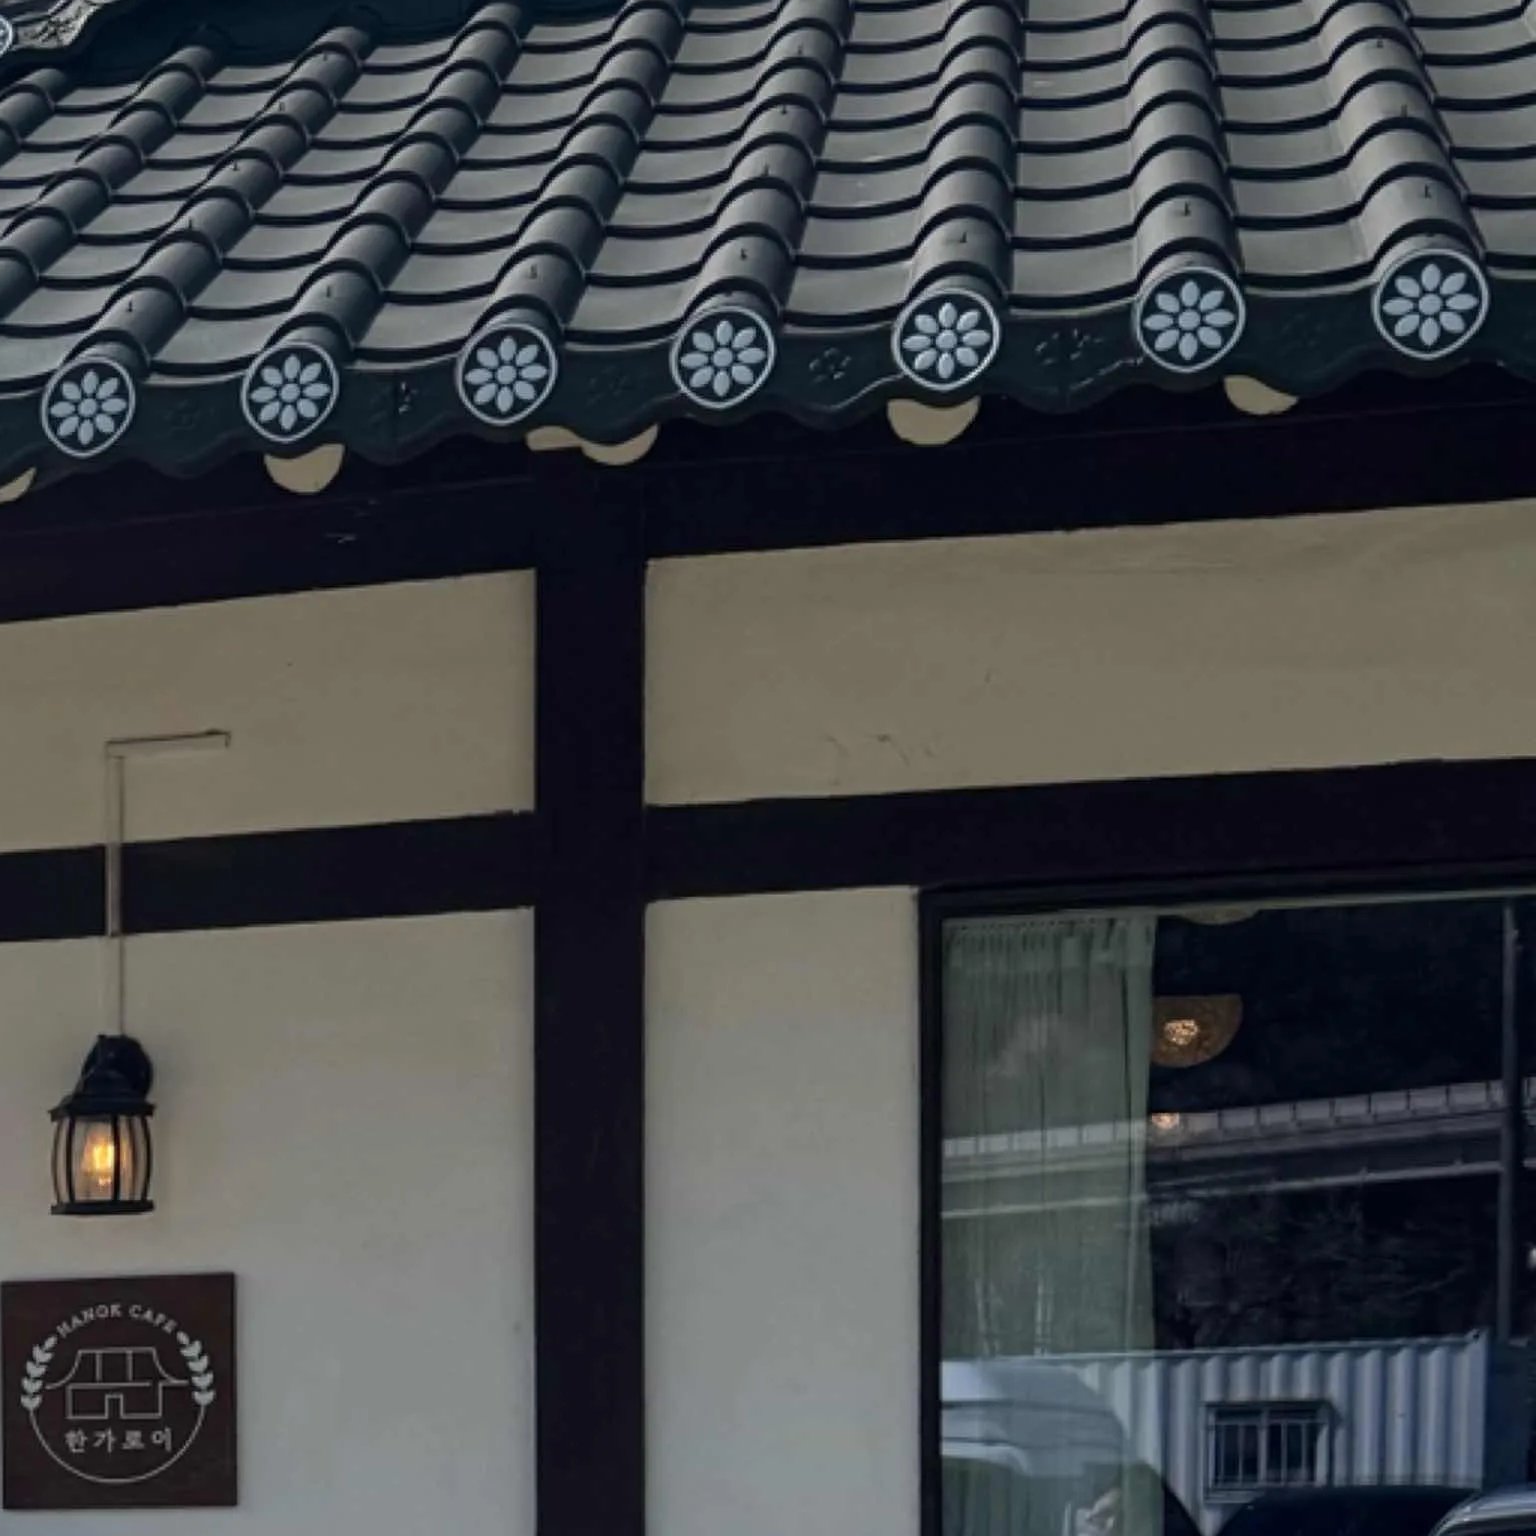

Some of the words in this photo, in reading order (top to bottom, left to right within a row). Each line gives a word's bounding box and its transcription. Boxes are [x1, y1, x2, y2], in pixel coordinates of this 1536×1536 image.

[56, 1304, 121, 1338] HANOK
[128, 1304, 177, 1334] CAFE
[65, 1427, 172, 1453] 한가로이
